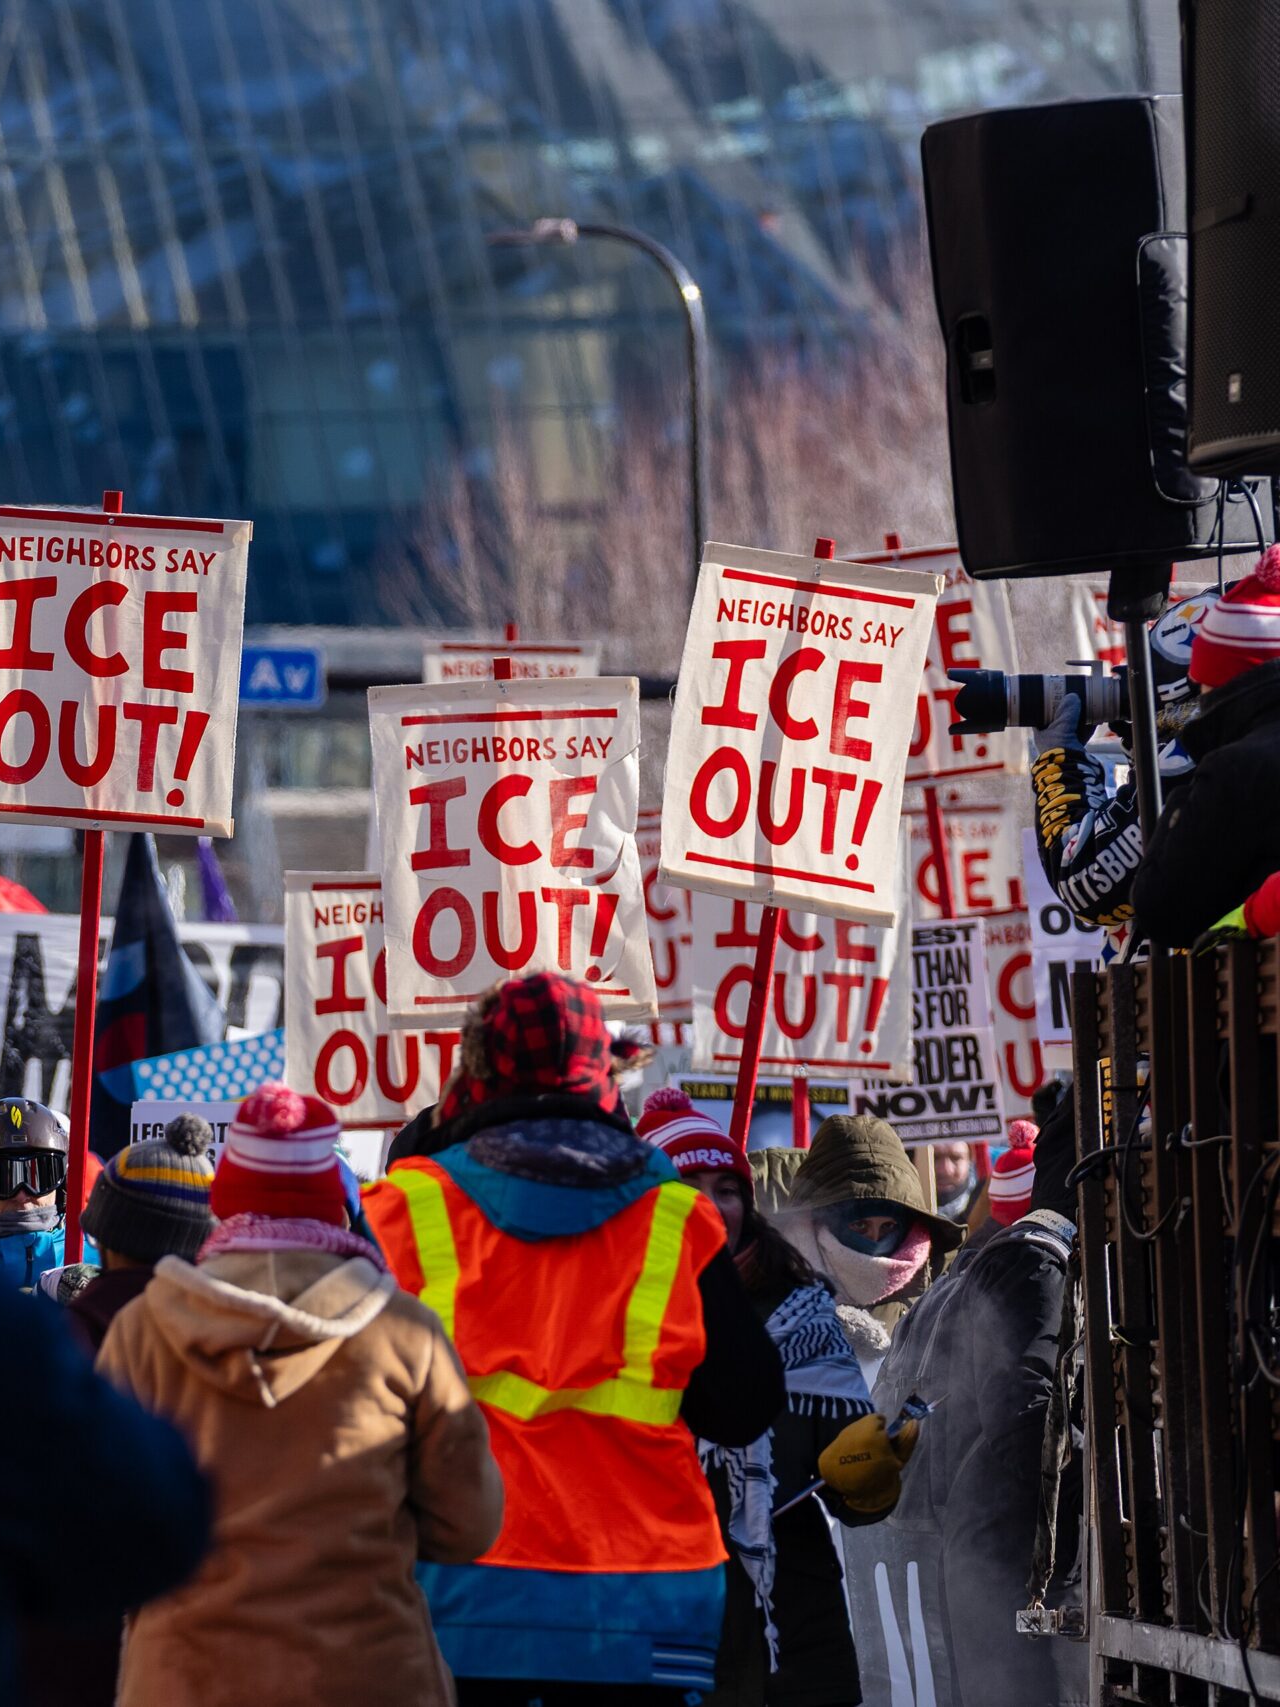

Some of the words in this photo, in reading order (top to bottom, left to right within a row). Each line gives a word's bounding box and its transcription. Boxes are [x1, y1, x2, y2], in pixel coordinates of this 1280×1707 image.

[164, 548, 216, 576] SAY
[945, 568, 978, 588] SA
[717, 598, 853, 641] NEIGHBORS
[860, 620, 905, 649] SAY
[441, 661, 541, 678] NEIGRS
[701, 639, 883, 761] ICE
[406, 735, 557, 770] NEIGHBORS
[566, 736, 613, 760] SAY
[409, 773, 598, 871] ICE
[690, 747, 883, 870] OUT!
[314, 902, 384, 928] NEIGH
[411, 886, 619, 983] OUT!
[714, 964, 889, 1053] OUT!
[926, 988, 969, 1028] FOR
[314, 1028, 461, 1106] OUT
[855, 1084, 996, 1119] NOW!
